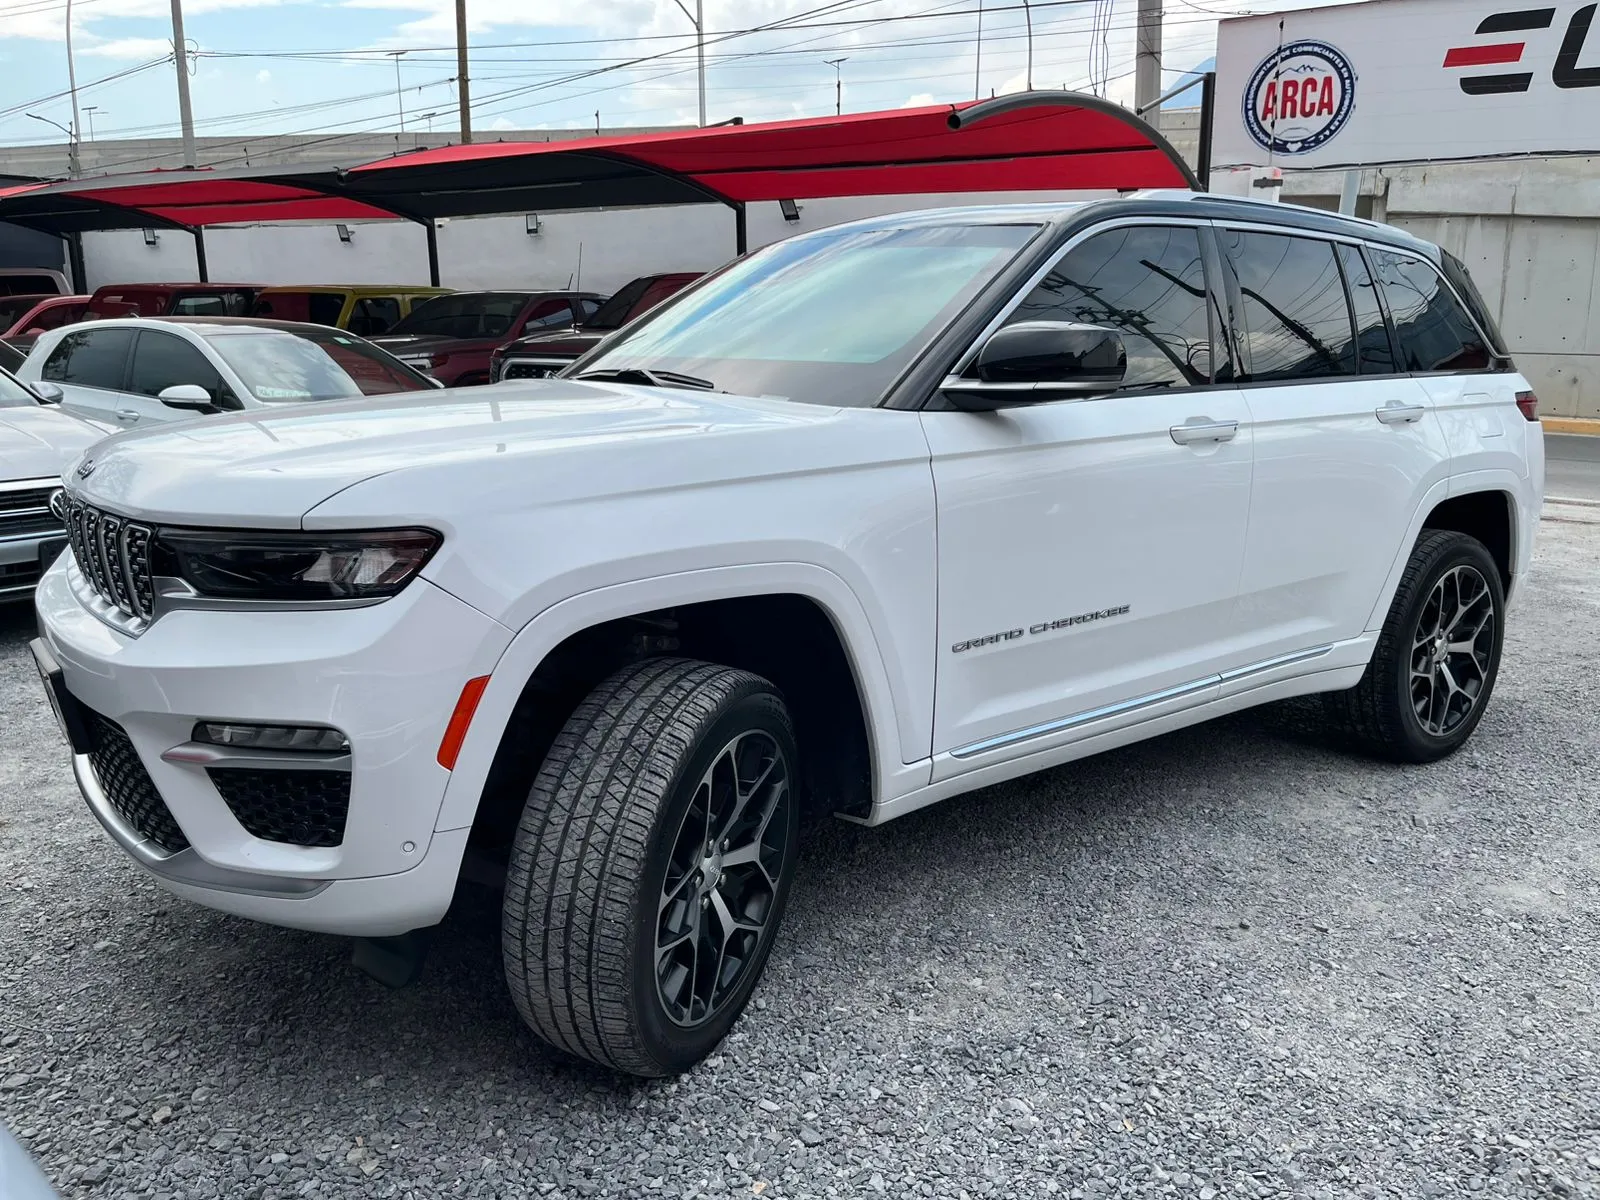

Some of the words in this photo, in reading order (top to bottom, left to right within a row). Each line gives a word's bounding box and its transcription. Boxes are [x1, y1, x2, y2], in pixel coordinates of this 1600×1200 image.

[1292, 46, 1344, 68] COMERCIANTES
[1341, 67, 1349, 78] EN
[1261, 76, 1333, 121] ARCA
[1330, 79, 1351, 131] AUTOMOVILES
[951, 628, 1024, 653] GRAND
[1029, 604, 1130, 635] CHEROKEE
